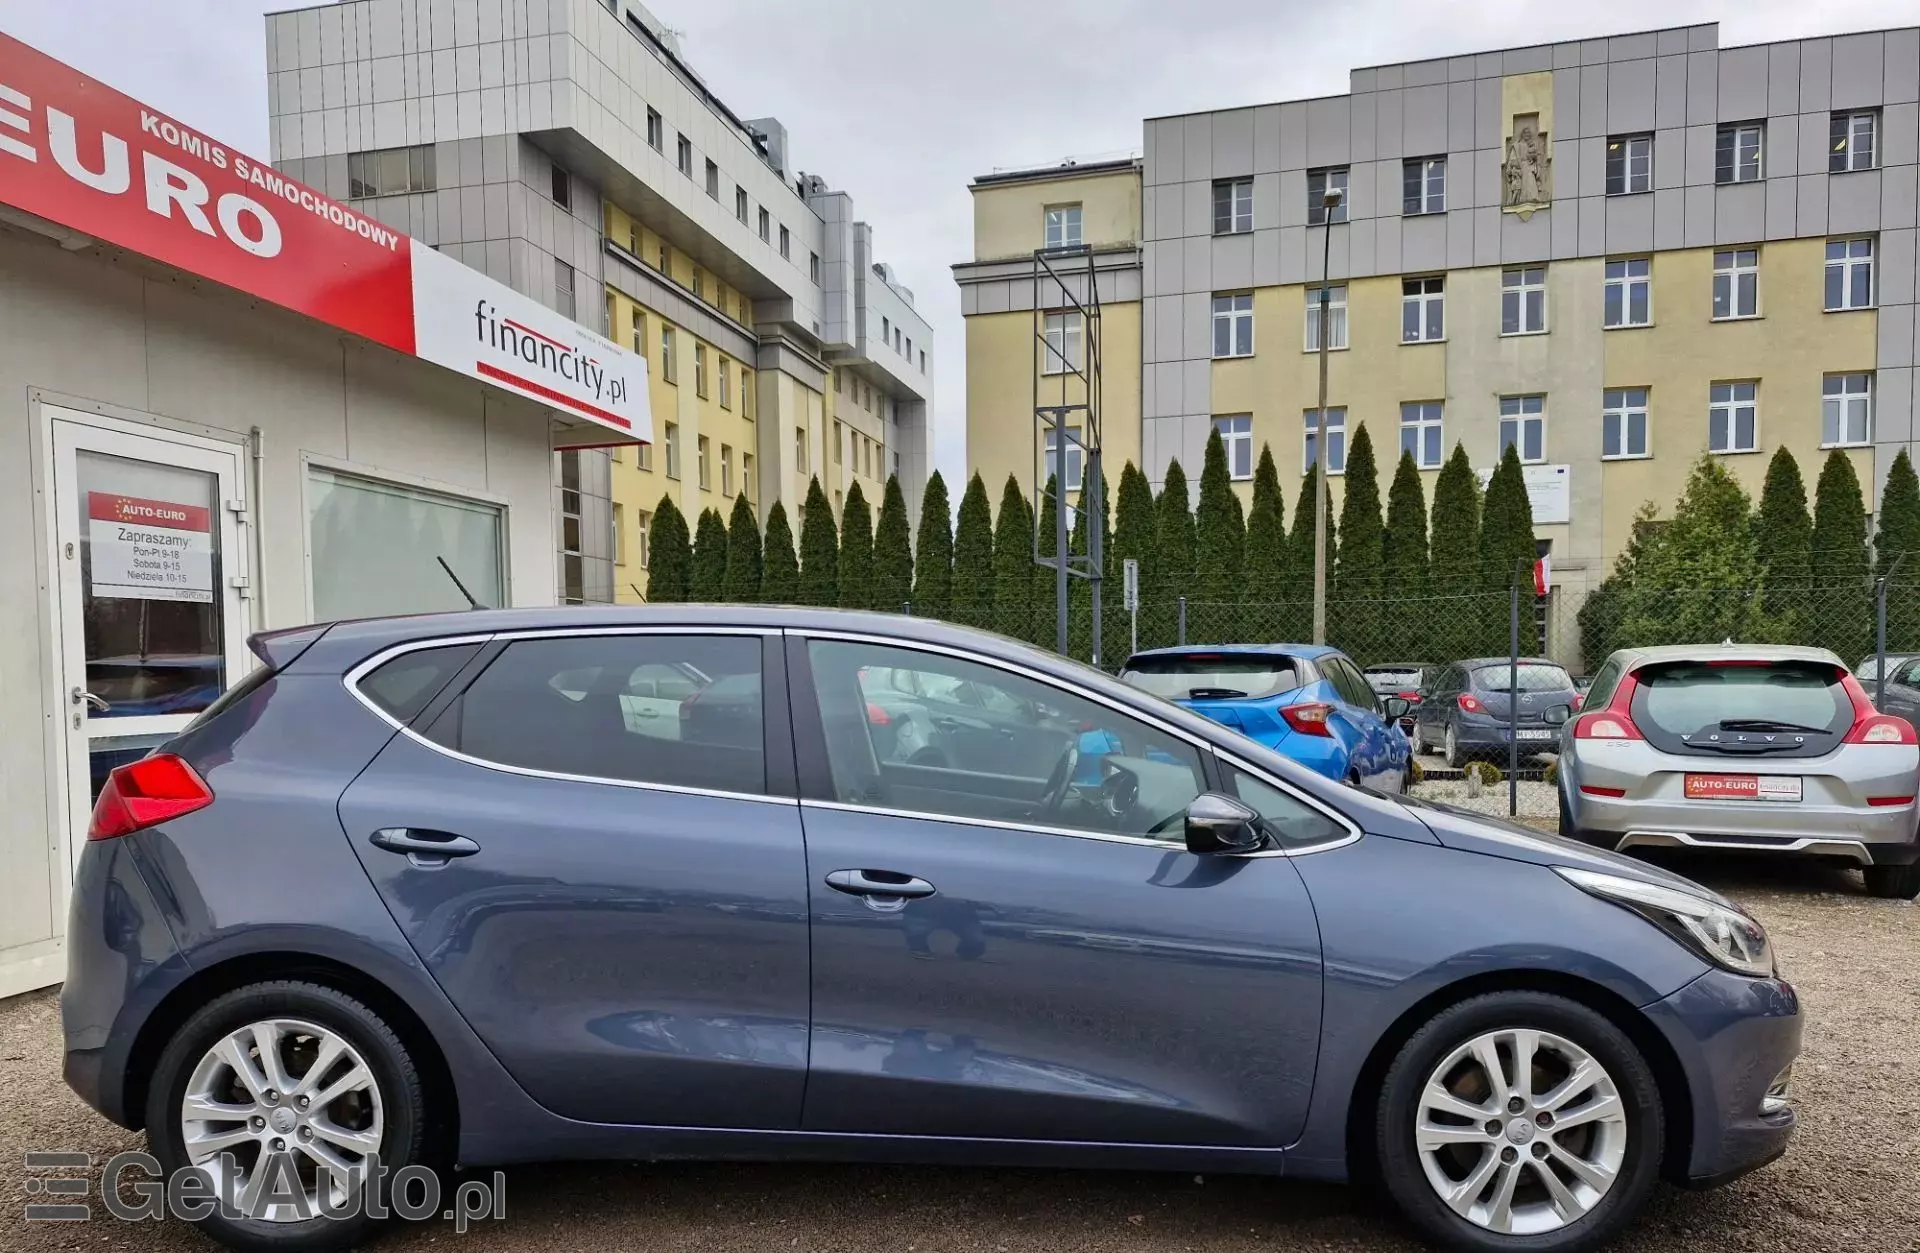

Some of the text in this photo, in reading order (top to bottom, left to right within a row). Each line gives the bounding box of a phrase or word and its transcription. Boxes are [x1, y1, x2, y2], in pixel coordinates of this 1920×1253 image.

[140, 110, 399, 252] KOMIS SAMOCHODOWY
[475, 299, 627, 405] financity.pl
[122, 504, 187, 521] AUTO-EURO
[117, 527, 192, 550] Zapraszamy:
[133, 558, 181, 571] Sobota 9-15
[127, 570, 187, 583] Niedziela 10-15
[1682, 734, 1804, 742] VOLVO
[1692, 780, 1757, 791] AUTO-EURO
